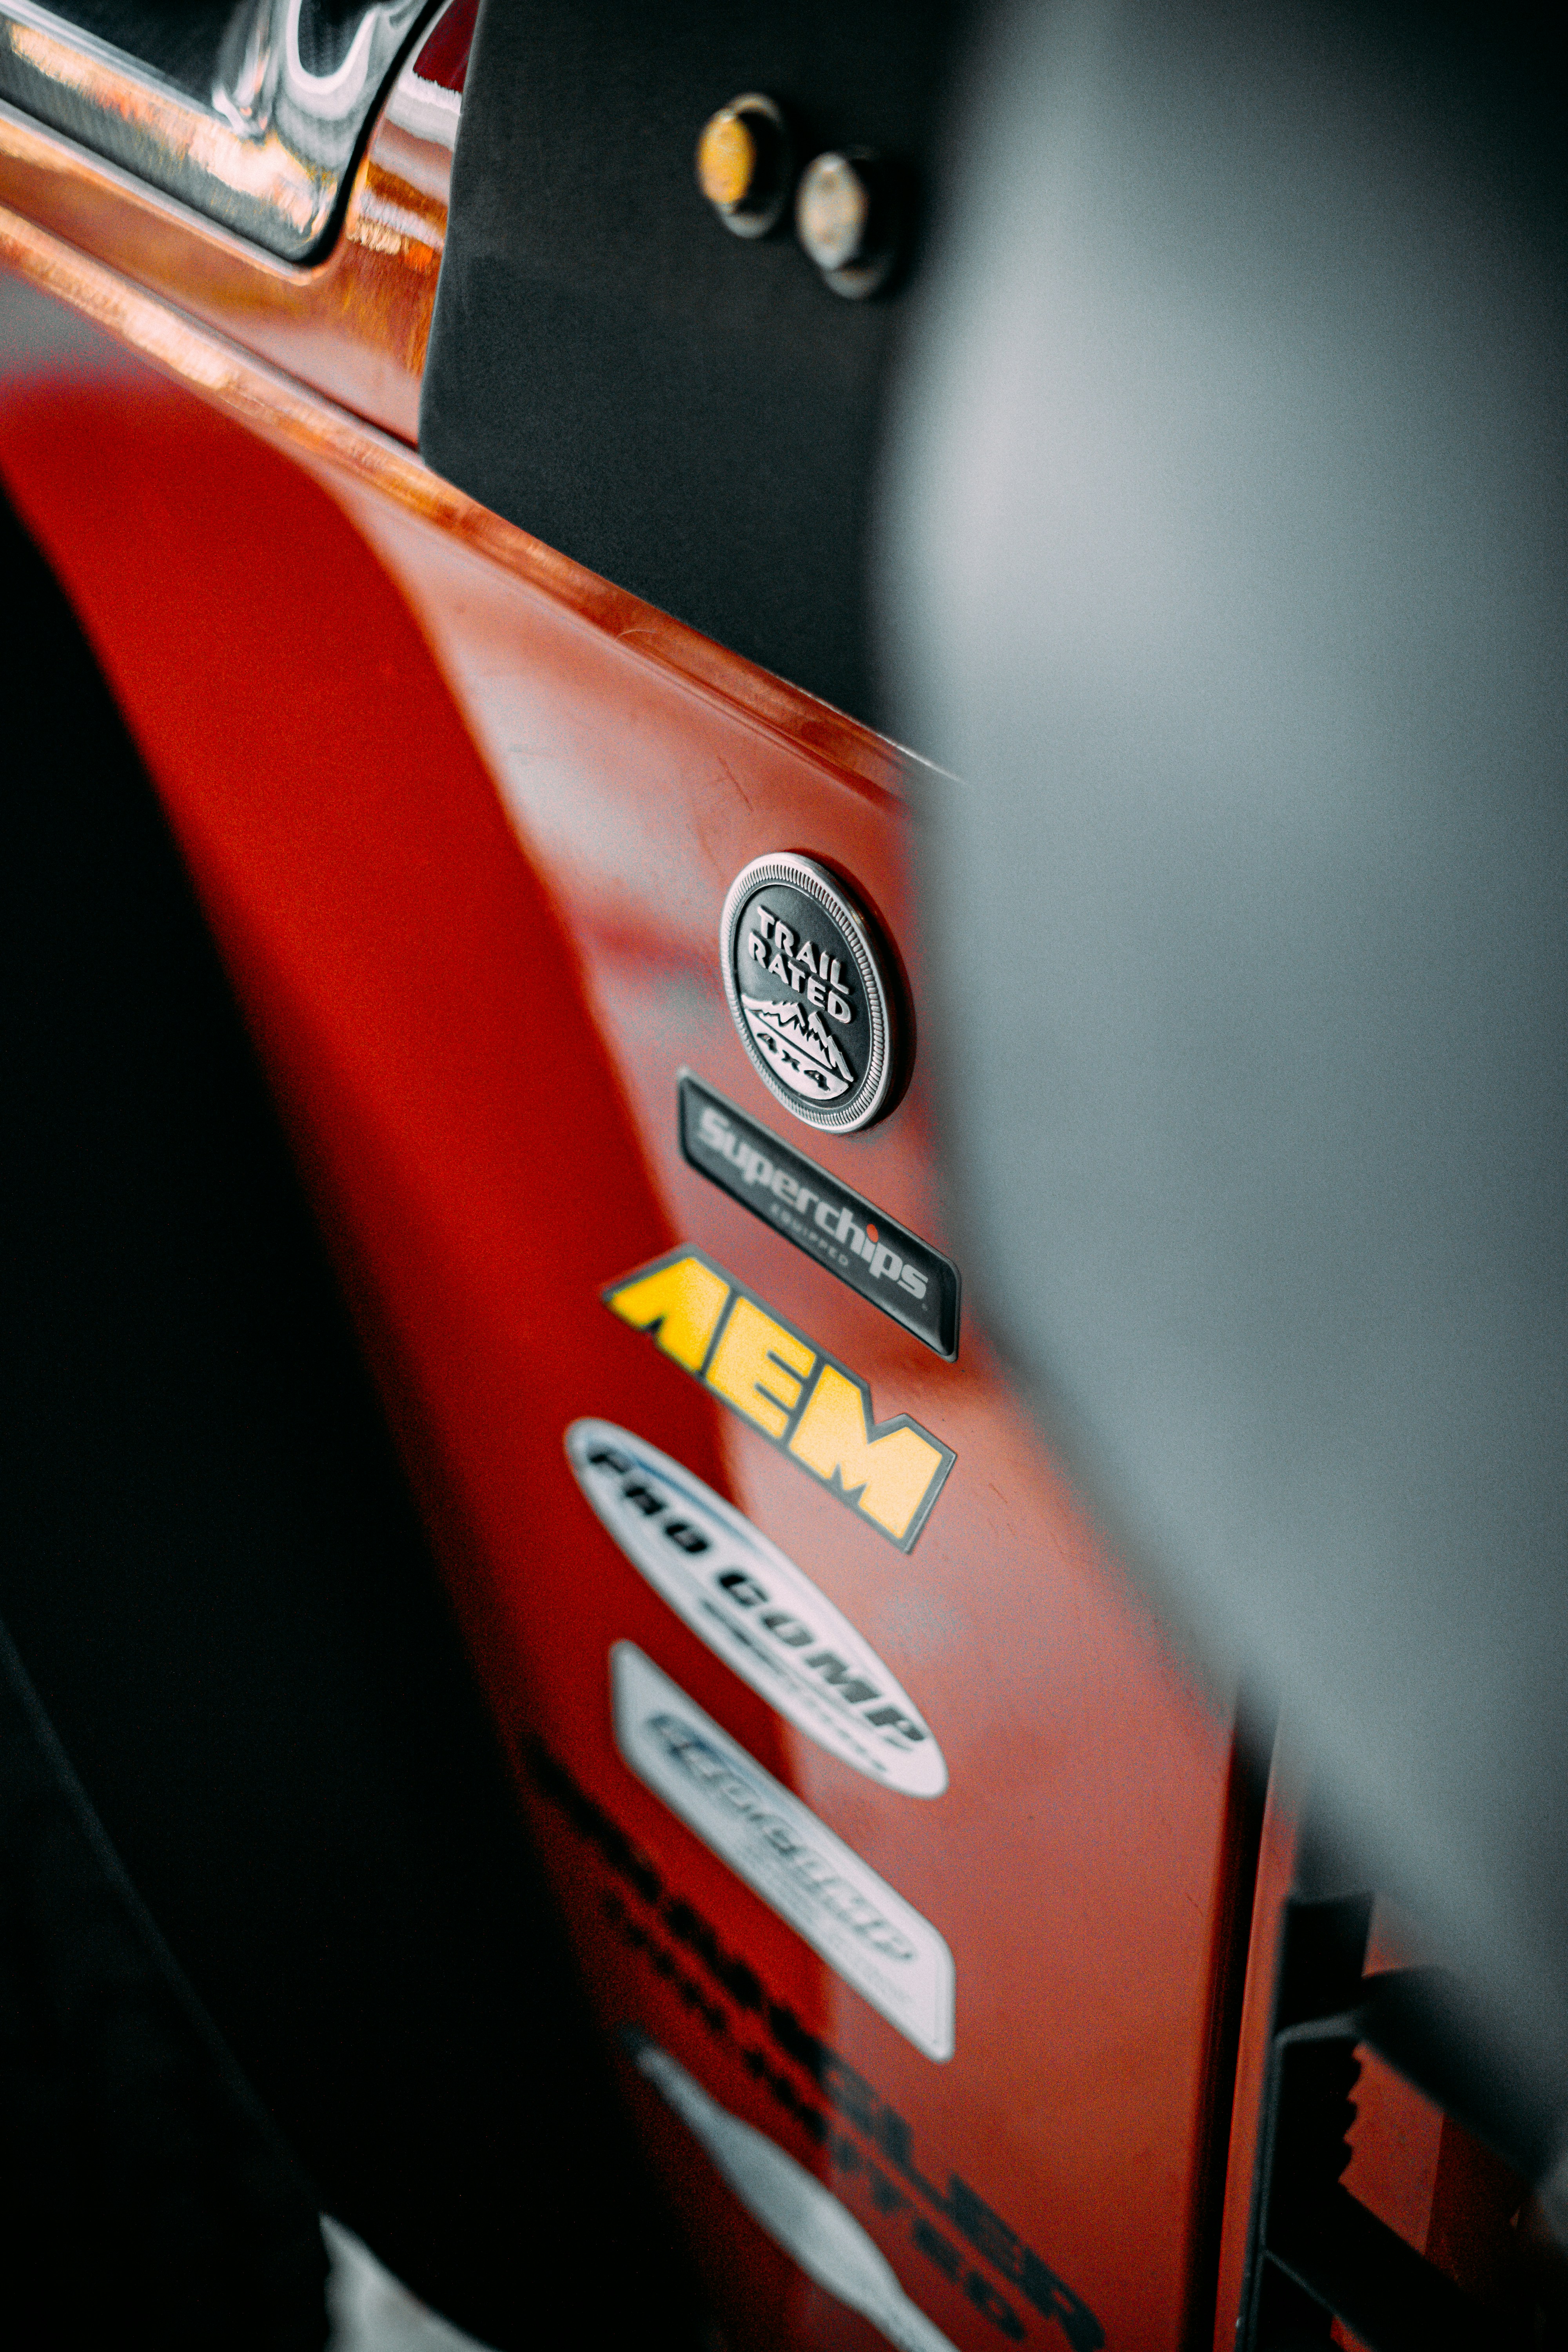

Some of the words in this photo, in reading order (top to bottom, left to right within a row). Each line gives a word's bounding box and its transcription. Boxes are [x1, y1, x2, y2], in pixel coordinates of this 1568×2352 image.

[748, 931, 851, 1024] RATED
[757, 905, 850, 994] TRAIL
[697, 1105, 929, 1299] Superchips
[612, 1256, 942, 1539] AEM
[717, 1568, 925, 1742] COMP
